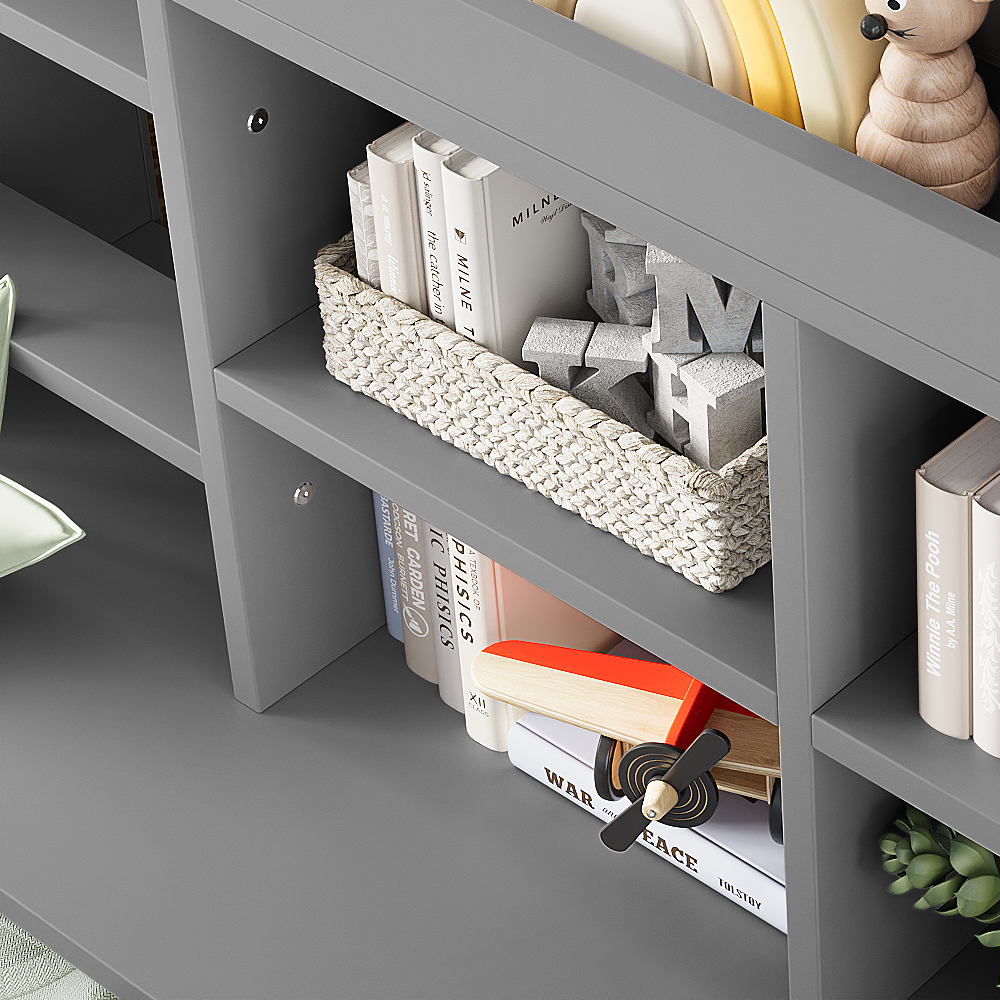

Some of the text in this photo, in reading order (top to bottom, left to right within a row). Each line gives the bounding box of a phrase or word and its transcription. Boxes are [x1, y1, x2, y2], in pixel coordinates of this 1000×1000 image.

[427, 230, 440, 250] the
[429, 253, 443, 302] catcher
[456, 253, 473, 312] MILNE
[434, 302, 445, 315] in
[387, 557, 396, 578] John
[397, 552, 409, 602] BURNETT
[433, 561, 455, 651] PHISICS
[451, 538, 474, 645] PHISICS
[924, 530, 941, 678] Winnie The Pooh
[945, 592, 956, 617] Milne
[946, 636, 958, 649] by
[468, 701, 490, 718] CLASS
[469, 690, 486, 709] XII
[544, 766, 596, 810] WAR
[717, 876, 762, 910] TOLSTOY
